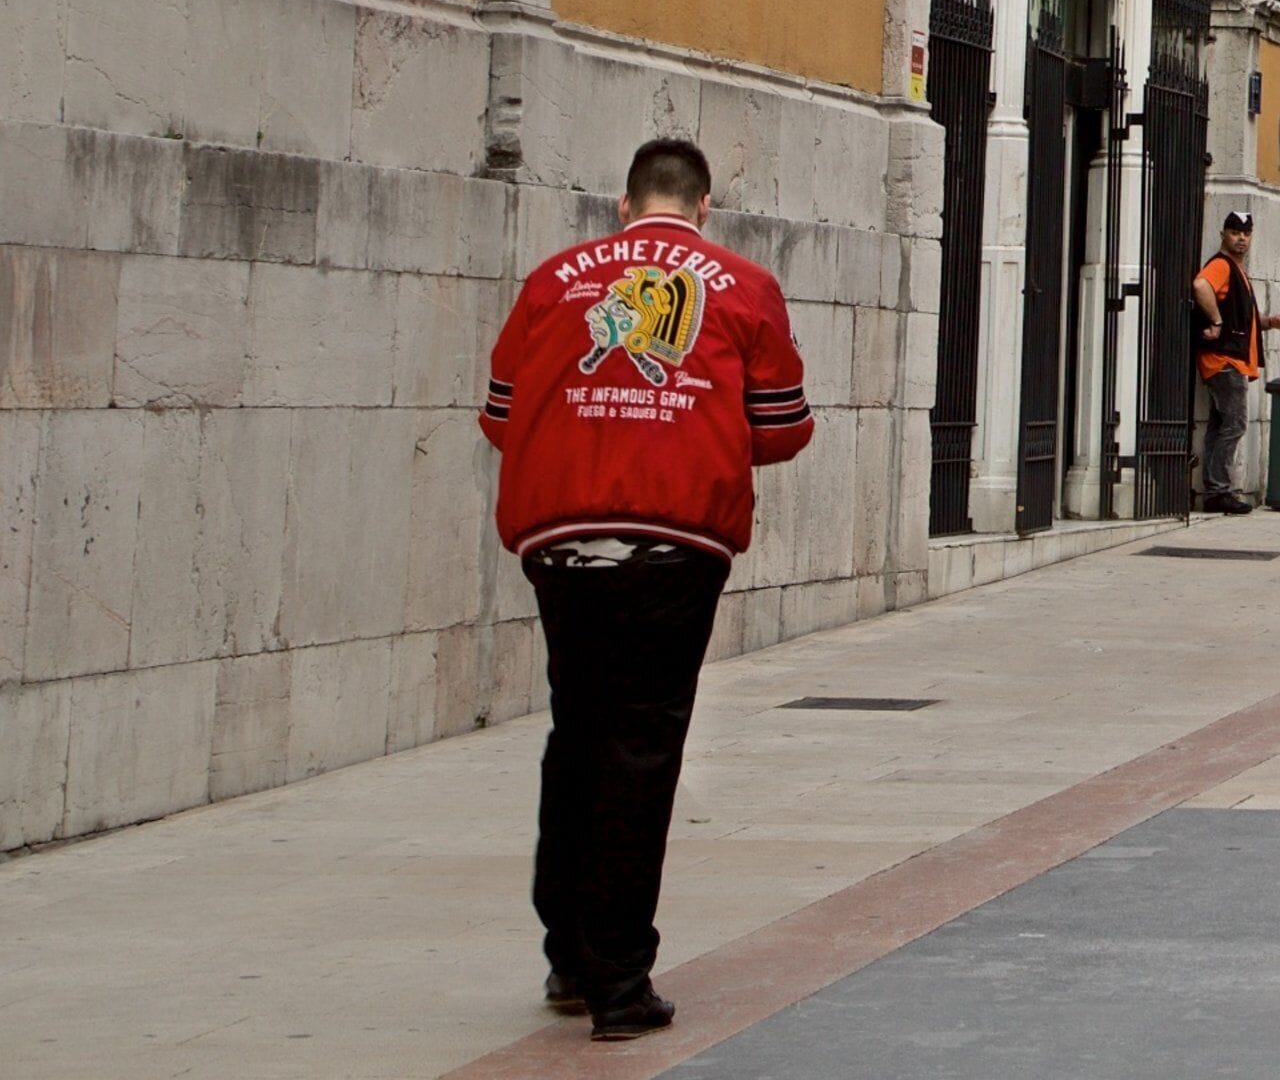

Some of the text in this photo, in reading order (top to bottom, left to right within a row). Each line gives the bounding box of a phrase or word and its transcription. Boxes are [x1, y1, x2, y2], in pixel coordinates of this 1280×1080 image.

[554, 239, 736, 292] MACHETEROS
[565, 387, 696, 410] THE INFAMOUS GRMY
[577, 405, 606, 417] FUEGO
[609, 407, 617, 418] &
